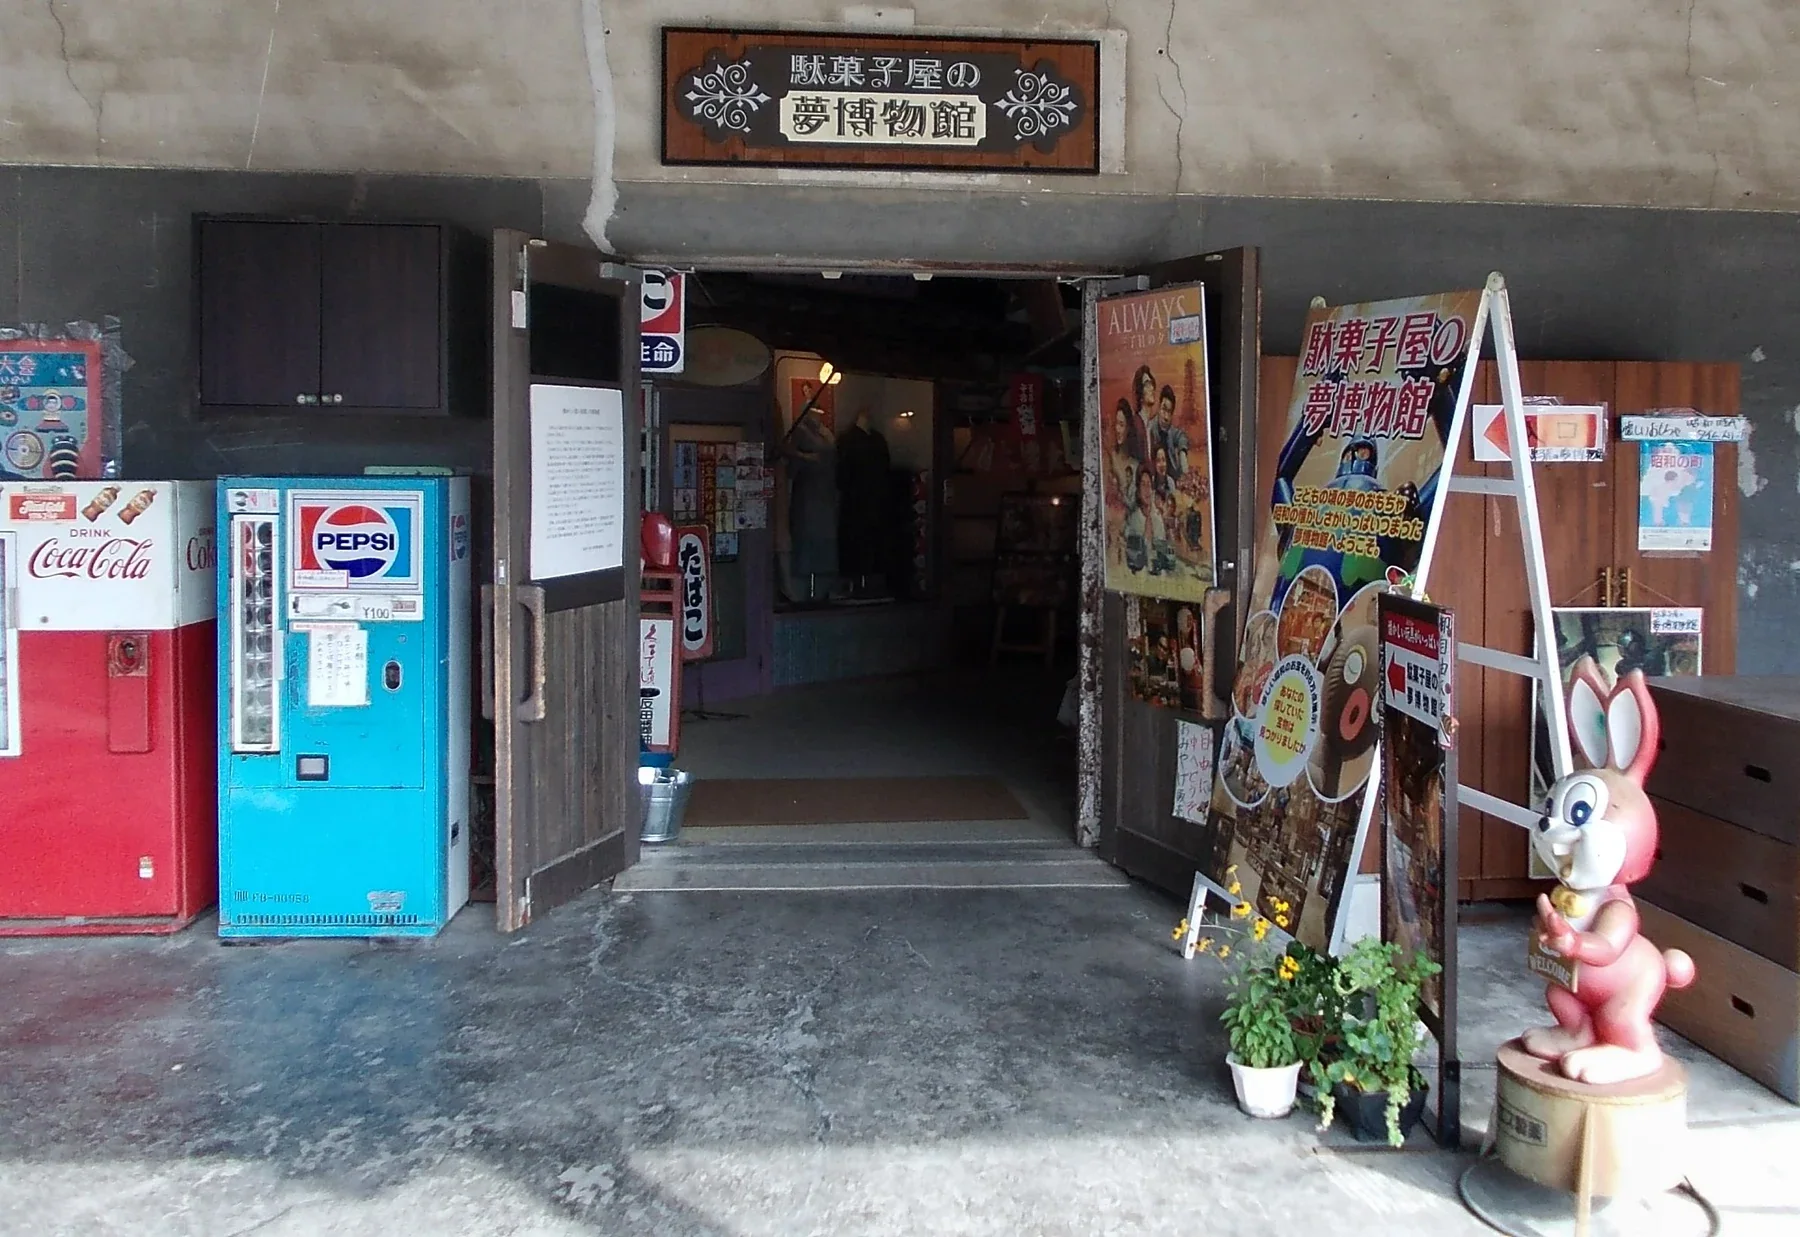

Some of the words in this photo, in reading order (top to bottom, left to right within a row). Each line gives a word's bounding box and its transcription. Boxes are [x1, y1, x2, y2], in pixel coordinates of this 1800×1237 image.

[789, 54, 981, 90] 駄菓子屋の
[791, 95, 977, 139] 夢博物館
[1108, 295, 1187, 335] ALWAYS
[1303, 312, 1467, 376] 駄菓子屋の
[1303, 376, 1435, 439] 夢博物館
[1650, 455, 1703, 469] 昭和の町
[1293, 486, 1407, 515] こどもの頃の夢のおもちゃ
[69, 529, 111, 538] DRINK
[317, 532, 395, 551] PEPSI
[1292, 527, 1381, 558] 夢博物館へようこそ。
[28, 537, 154, 580] Coca-Cola
[680, 541, 706, 642] たばこ
[1407, 661, 1438, 690] 駄菓子屋の
[1279, 685, 1305, 704] あなたの
[1407, 685, 1438, 718] 夢博物館
[1529, 955, 1571, 988] WELCOME
